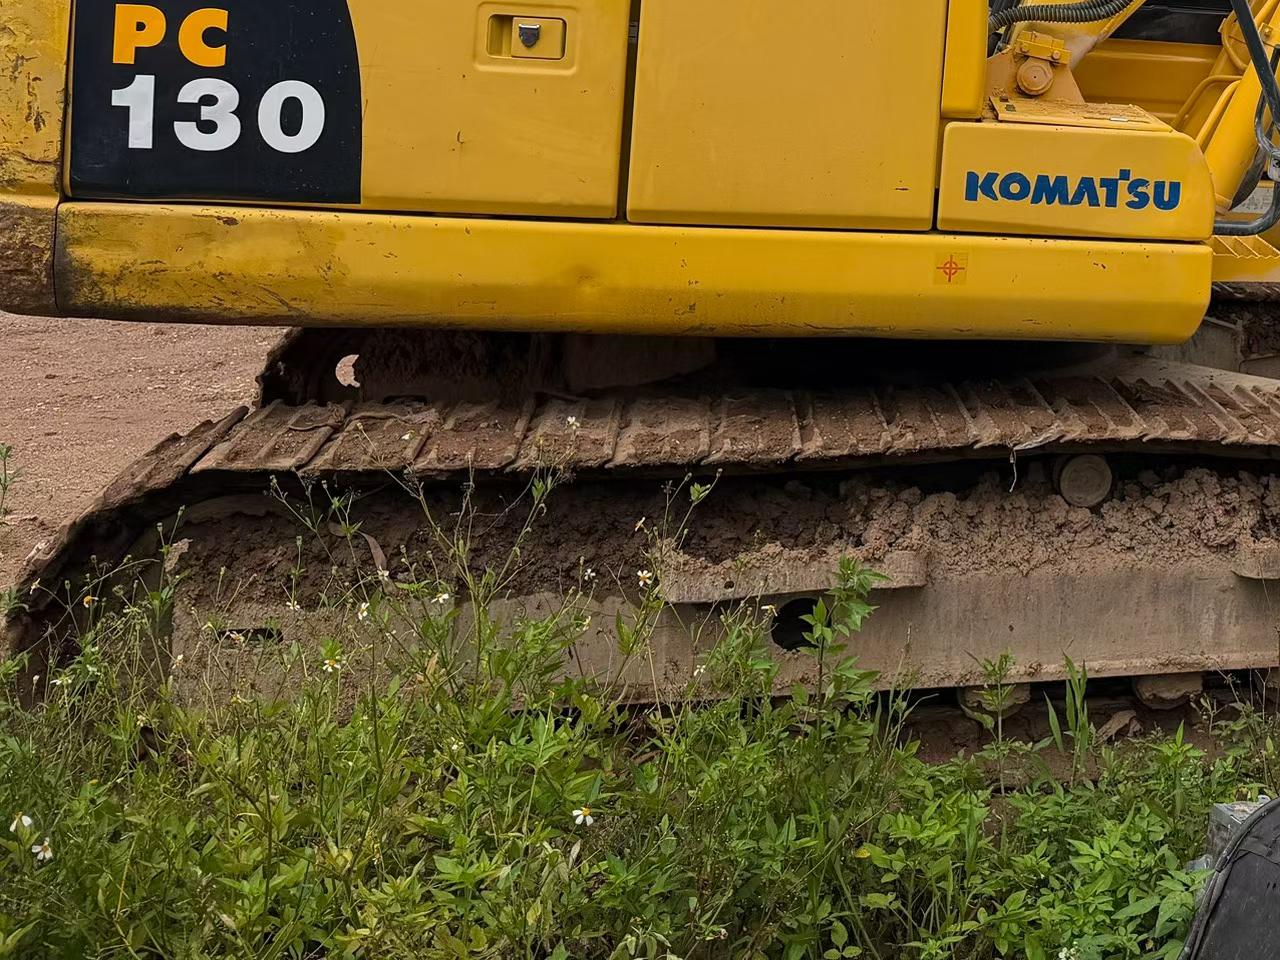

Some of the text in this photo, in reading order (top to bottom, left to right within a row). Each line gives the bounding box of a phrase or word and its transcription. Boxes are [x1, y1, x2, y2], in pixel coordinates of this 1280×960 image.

[112, 3, 229, 67] PC
[111, 74, 325, 153] 130
[965, 169, 1181, 210] KOMATSU
